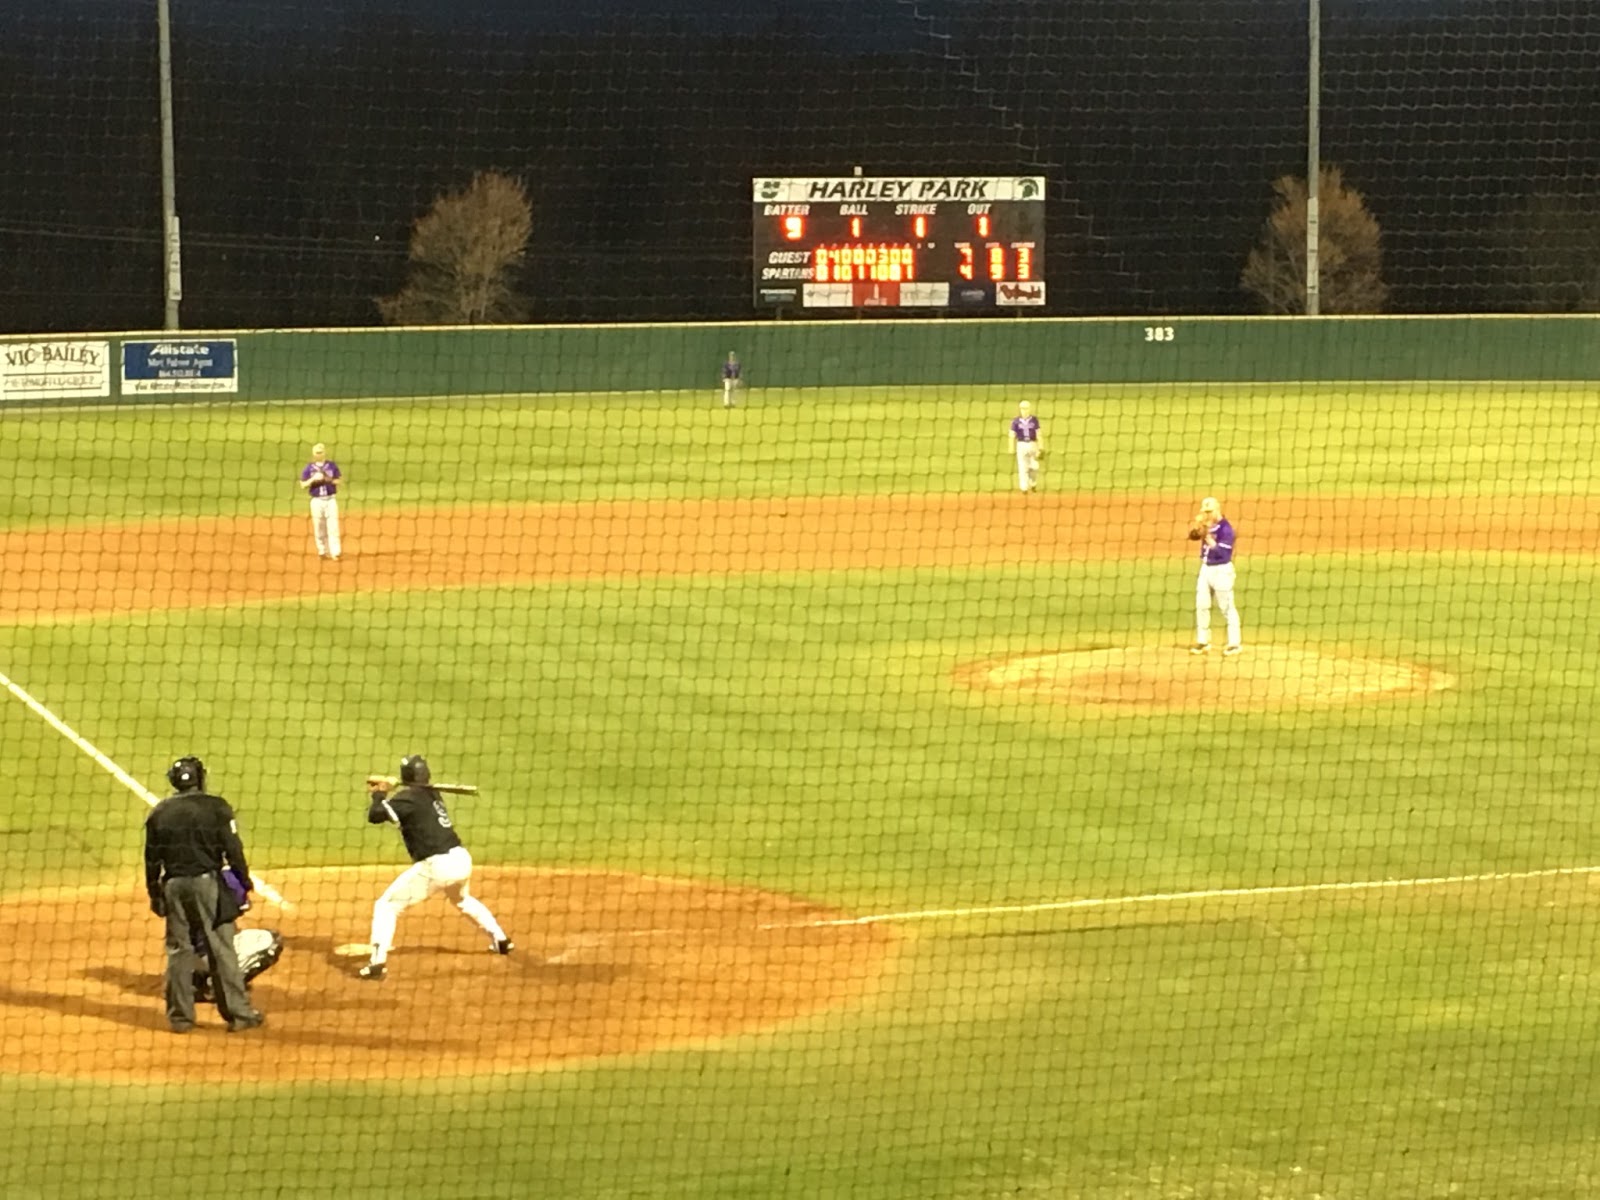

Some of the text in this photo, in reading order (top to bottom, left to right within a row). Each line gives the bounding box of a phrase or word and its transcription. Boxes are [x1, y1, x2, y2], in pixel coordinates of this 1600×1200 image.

[809, 180, 989, 199] HARLEY PARK
[764, 203, 992, 216] BATTER BALL STRIKE OUT
[784, 216, 989, 239] 9 1 1 1
[768, 252, 811, 264] GUEST
[762, 267, 815, 280] SPARTANS
[1144, 327, 1174, 341] 383
[150, 343, 210, 355] Allstate
[5, 346, 101, 366] VIC BAILEY
